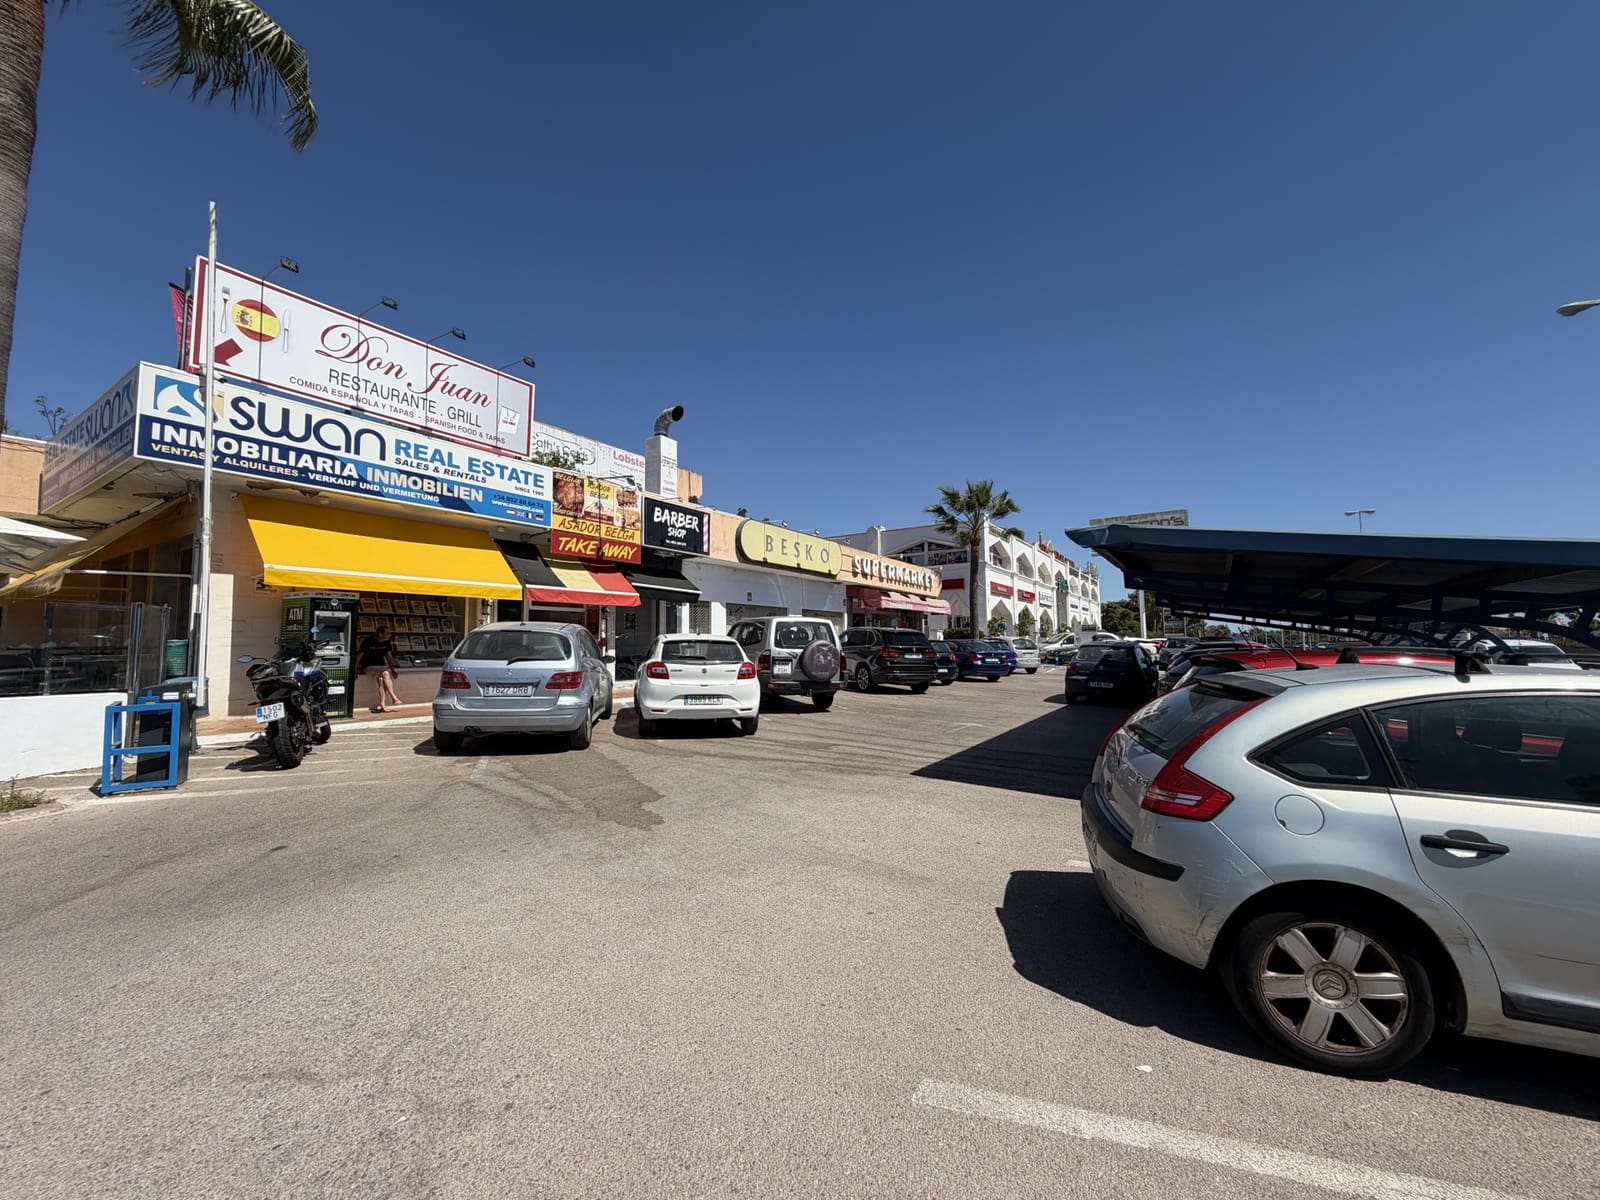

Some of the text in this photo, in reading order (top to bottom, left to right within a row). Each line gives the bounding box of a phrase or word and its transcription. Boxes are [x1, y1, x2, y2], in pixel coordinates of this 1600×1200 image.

[315, 324, 491, 408] Don Juan
[289, 376, 329, 394] COMIDA
[381, 402, 388, 410] Y
[389, 405, 415, 418] TAPAS
[425, 415, 457, 430] SPANISH
[458, 426, 478, 436] FOOD
[485, 432, 506, 444] TAPAS
[329, 368, 437, 414] RESTAURANTE
[447, 406, 482, 428] GRILL
[151, 422, 483, 502] INMOBILIARIA INMOBILIEN
[151, 442, 206, 460] VENTAS
[223, 457, 299, 477] ALQUILERES
[307, 472, 357, 487] VERKAUF
[359, 482, 380, 492] UND
[382, 486, 440, 503] VERMIETUNG
[394, 438, 545, 489] REAL ESTATE
[394, 457, 487, 484] SALES & RENTALS
[613, 450, 645, 468] Lobste
[559, 518, 635, 541] ASADOR BELGA
[653, 506, 700, 533] BARBER
[667, 527, 687, 539] SHOP
[559, 537, 637, 560] TAKE AWAY
[765, 534, 830, 564] BESKO
[855, 555, 935, 588] SUPERMARKET
[288, 608, 303, 621] ATM
[319, 602, 343, 611] ATM
